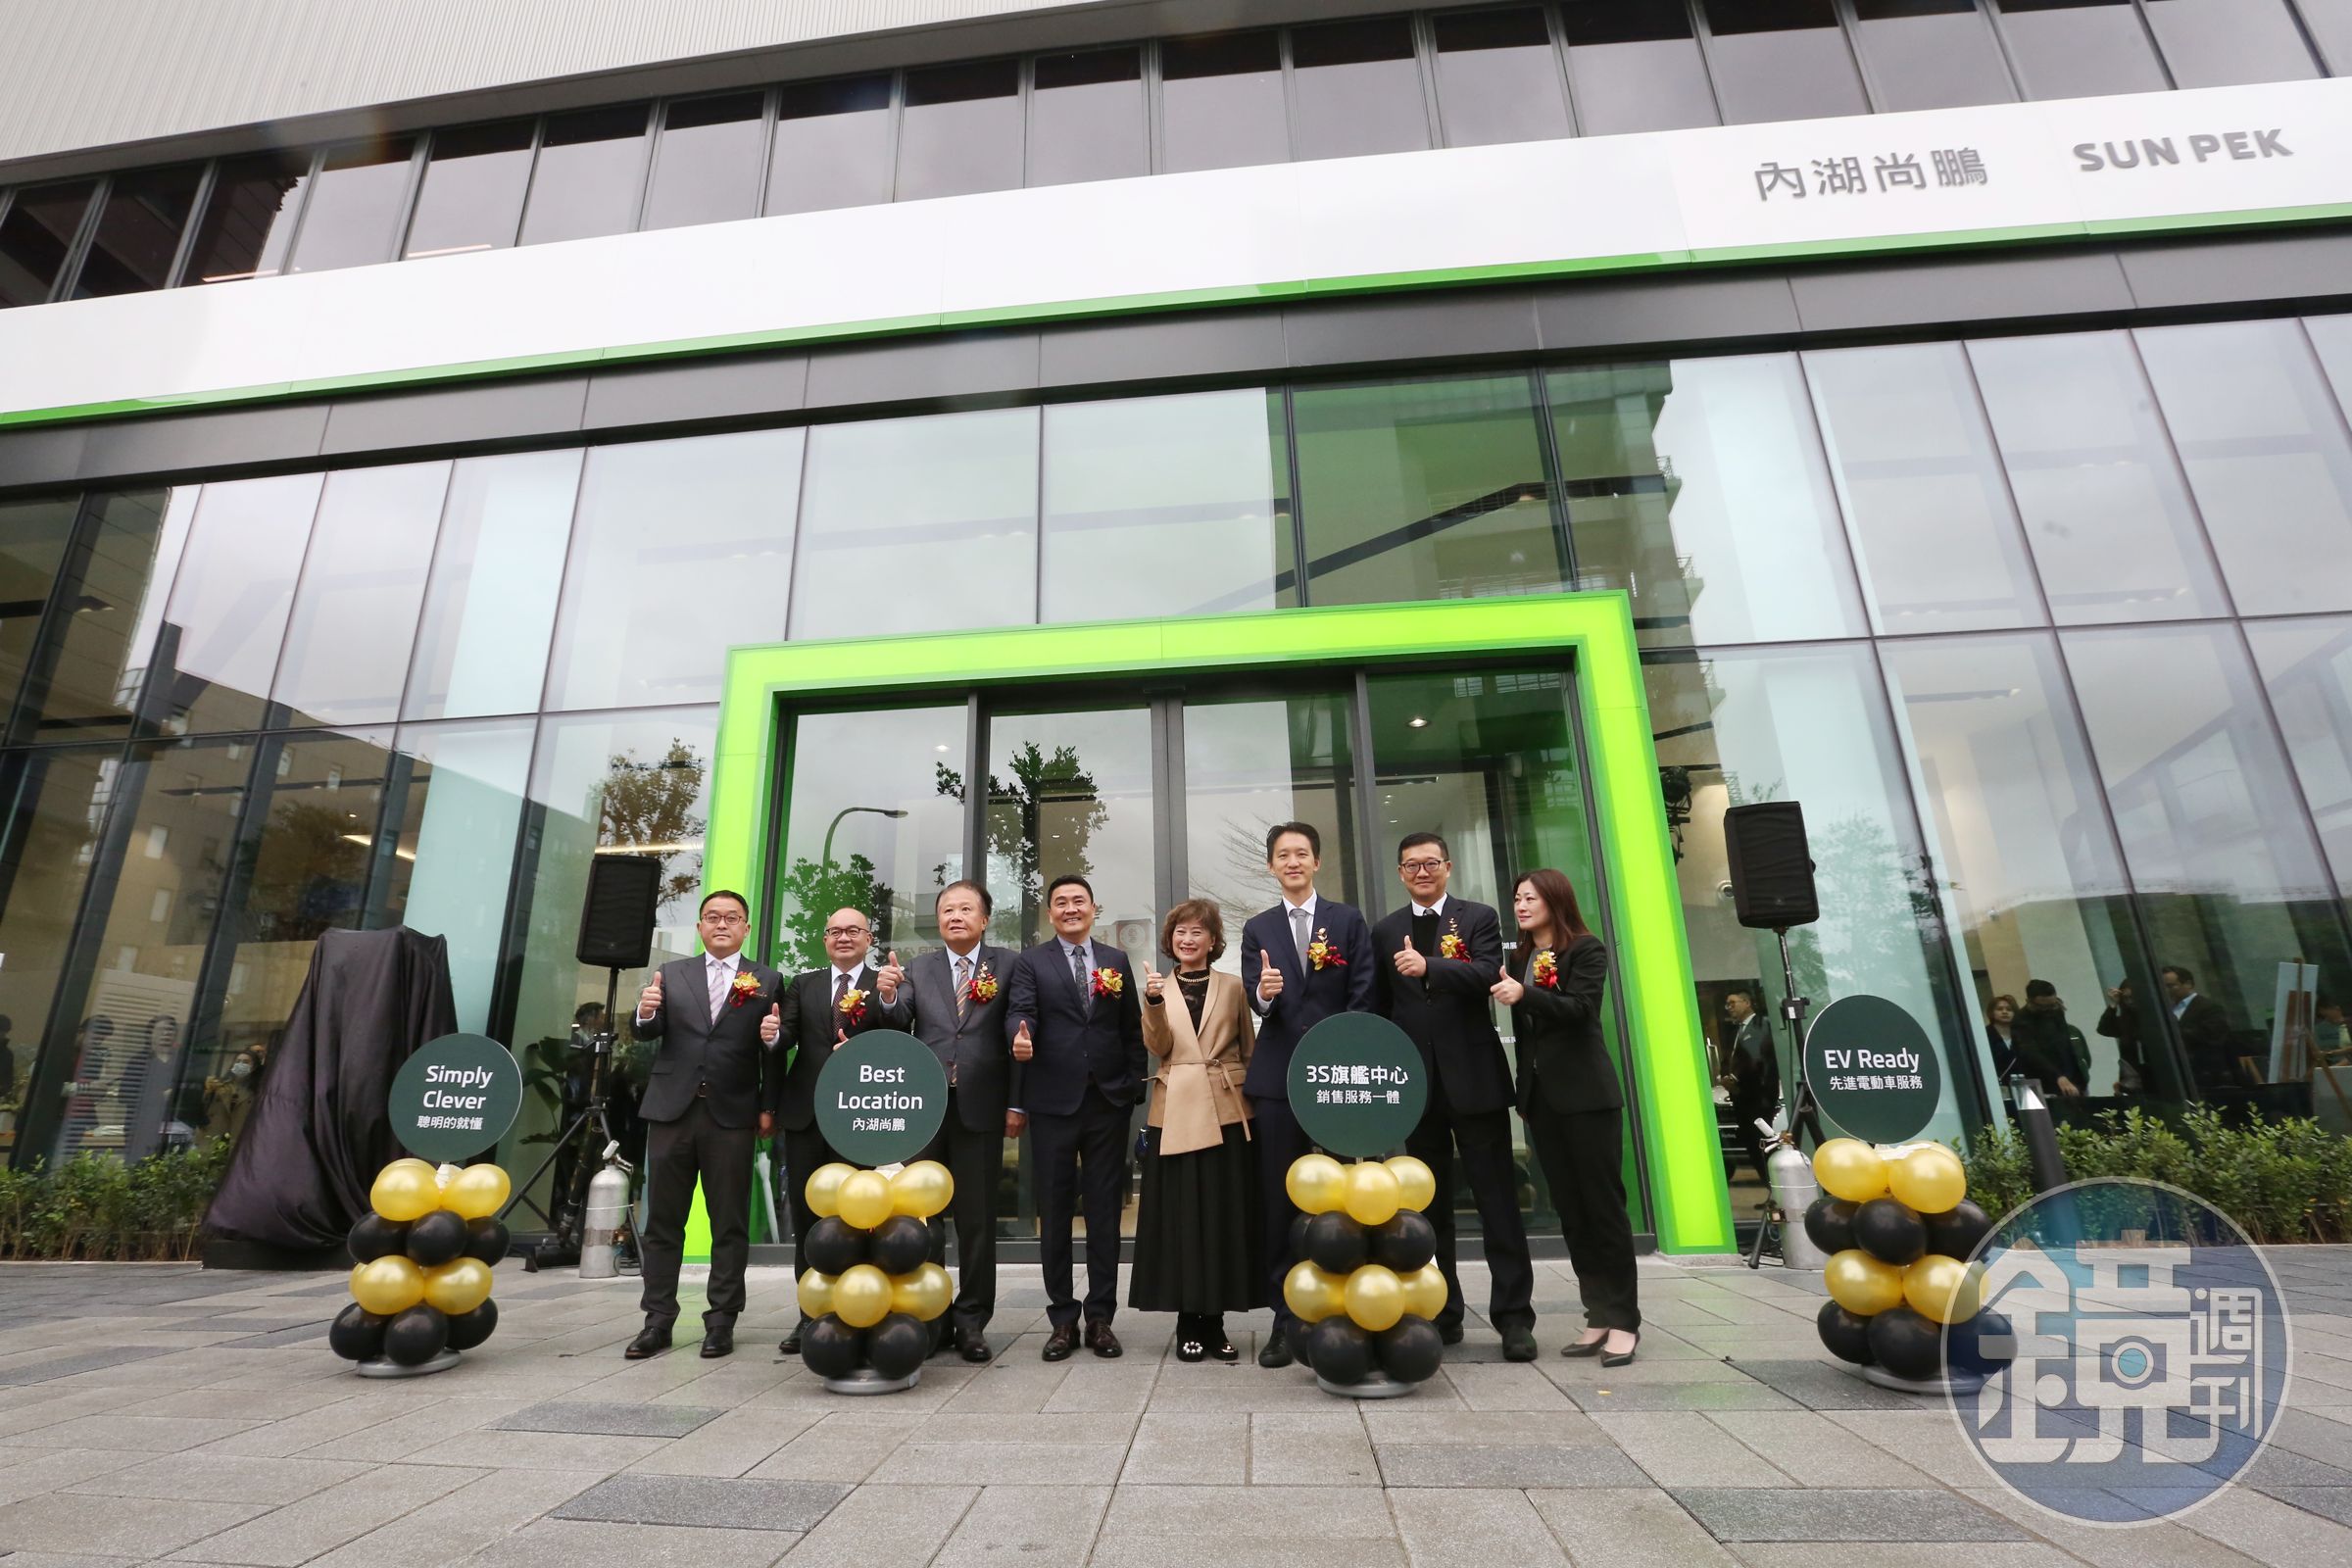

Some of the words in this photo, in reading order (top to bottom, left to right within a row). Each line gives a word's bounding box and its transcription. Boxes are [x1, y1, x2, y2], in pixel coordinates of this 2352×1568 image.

[2073, 137, 2180, 172] SUN
[2188, 128, 2295, 164] PEK
[1754, 147, 1988, 202] 內湖尚鵬
[1824, 1050, 1852, 1069] EV
[1857, 1047, 1920, 1073] Ready
[425, 1065, 494, 1089] Simply
[859, 1064, 906, 1083] Best
[1306, 1065, 1409, 1085] 3S旗艦中心
[1830, 1075, 1923, 1091] 先進電動車服務
[422, 1090, 487, 1109] Clever
[838, 1091, 923, 1110] Location
[1316, 1090, 1400, 1104] 銷售服務一體
[416, 1115, 483, 1130] 聰明的就懂
[853, 1117, 906, 1132] 內湖尚鵬
